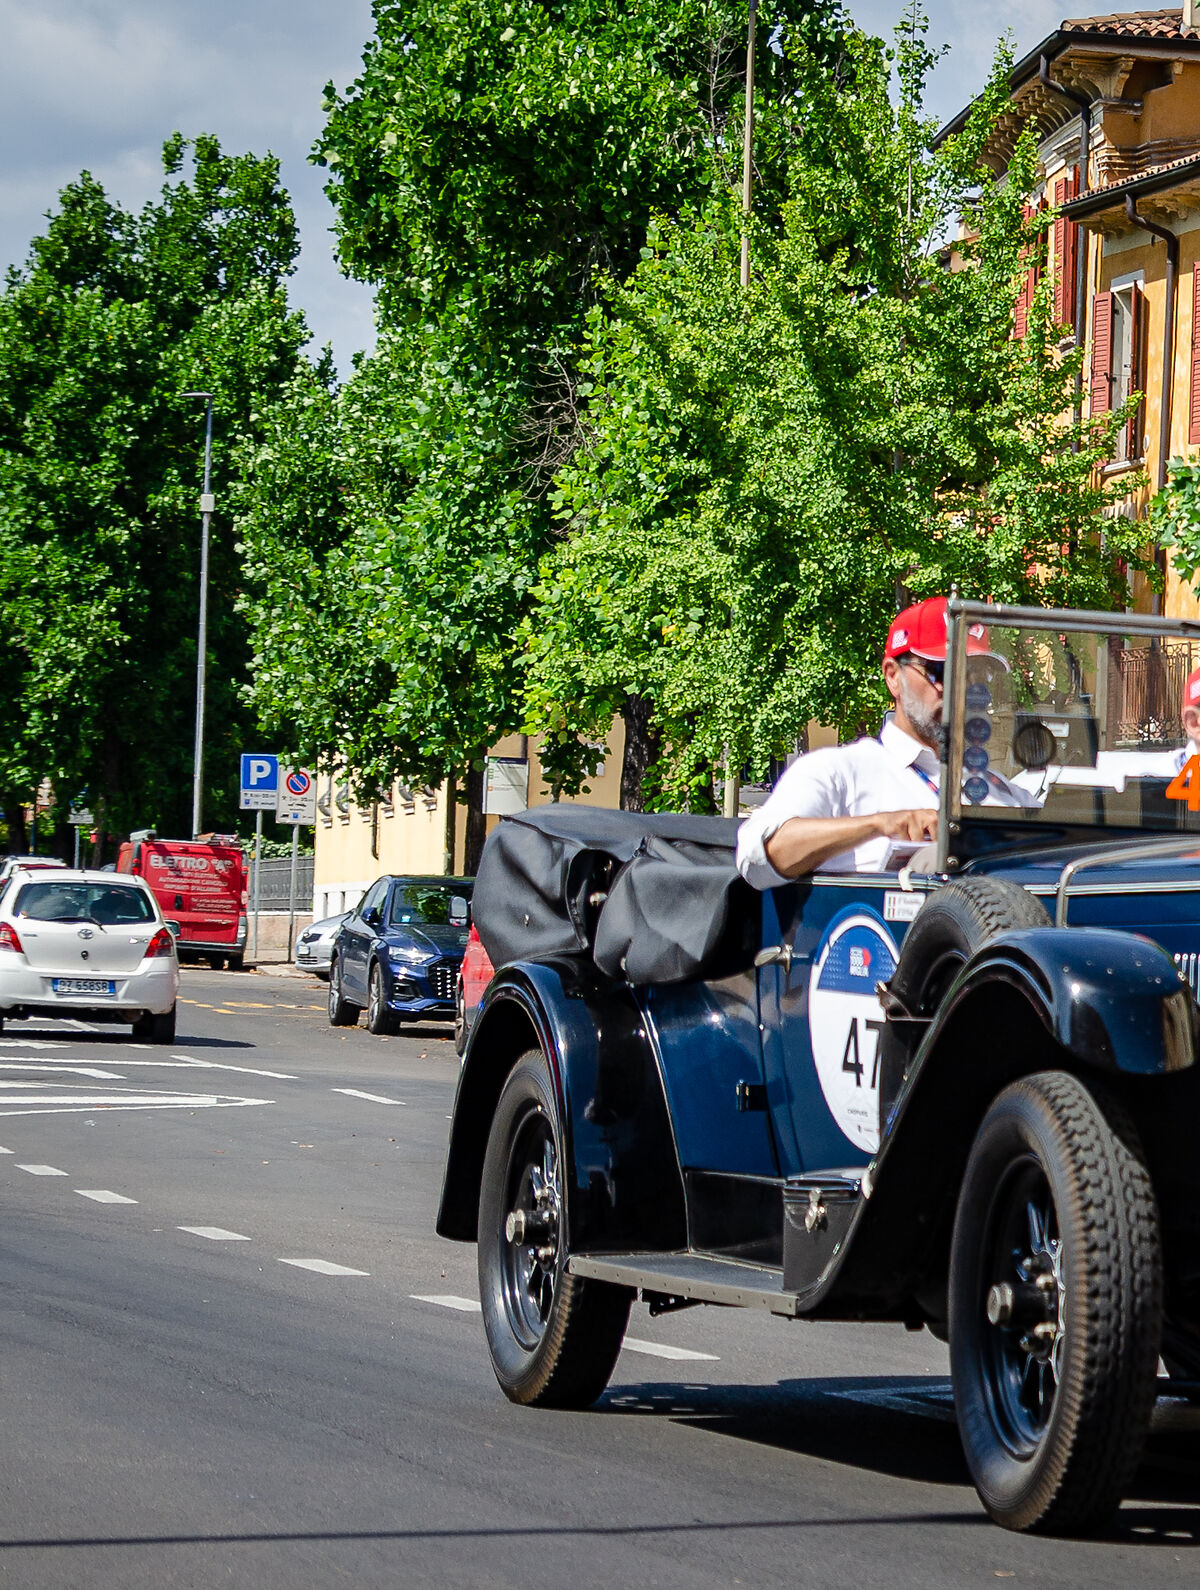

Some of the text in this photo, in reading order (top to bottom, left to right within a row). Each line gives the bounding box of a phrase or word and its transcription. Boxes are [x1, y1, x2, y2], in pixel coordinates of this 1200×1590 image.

[250, 760, 271, 785] P
[150, 854, 208, 870] ELETTRO
[842, 1017, 884, 1089] 47
